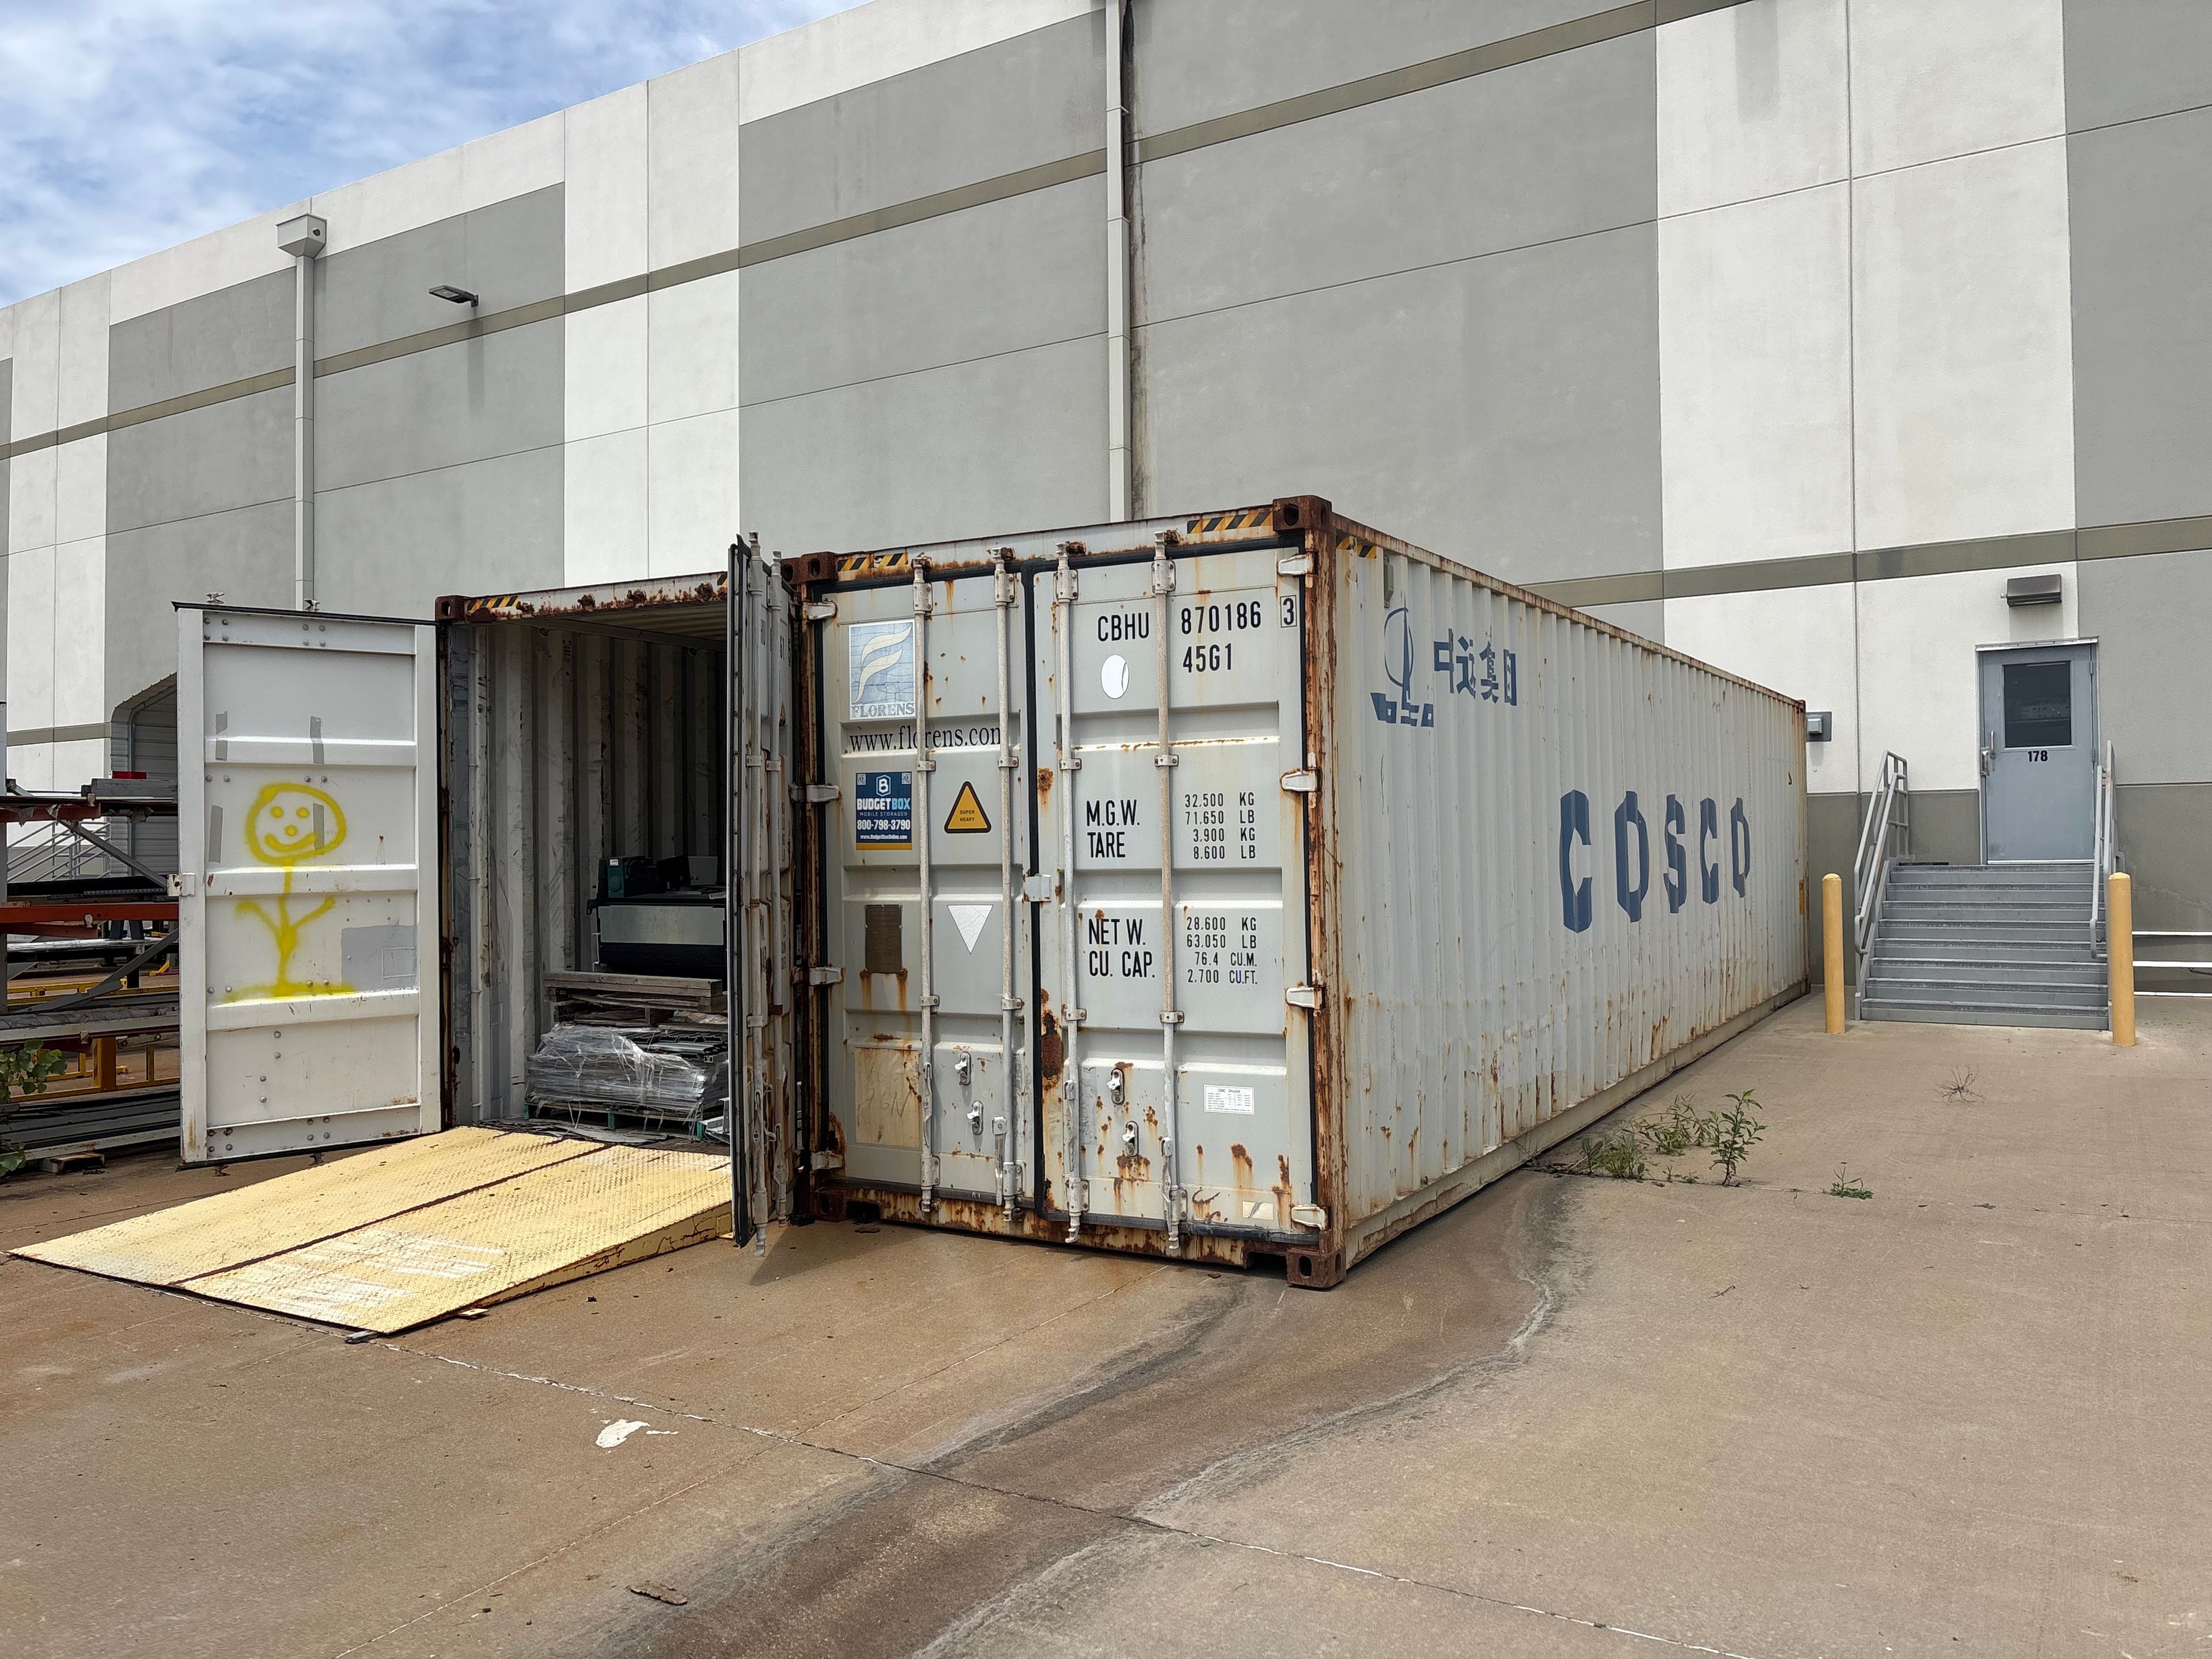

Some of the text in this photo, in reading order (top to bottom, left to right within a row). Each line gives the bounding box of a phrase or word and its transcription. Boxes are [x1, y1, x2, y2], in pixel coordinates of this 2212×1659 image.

[1097, 597, 1294, 642] CBHU 870186 3
[1183, 643, 1232, 673] 45G1
[851, 702, 915, 718] FLORENS
[2028, 750, 2048, 762] 178
[1184, 791, 1254, 808] 32,500 KG
[1086, 799, 1140, 827] M.G.W.
[1185, 809, 1255, 825] 71,650 LB
[857, 819, 911, 830] 800-798-3790
[1193, 827, 1255, 842] 3,900 KG
[1087, 831, 1126, 858] TARE
[1193, 844, 1256, 859] 8,600 LB
[1559, 789, 1751, 934] COSCO
[1089, 918, 1146, 945] NET W.
[1187, 916, 1256, 931] 28,600 KG
[1187, 934, 1256, 949] 63,050 LB
[1089, 950, 1155, 978] CU. CAP.
[1194, 952, 1257, 967] 76.4 CU.M.
[1187, 969, 1257, 984] 2,700 CU.FT.
